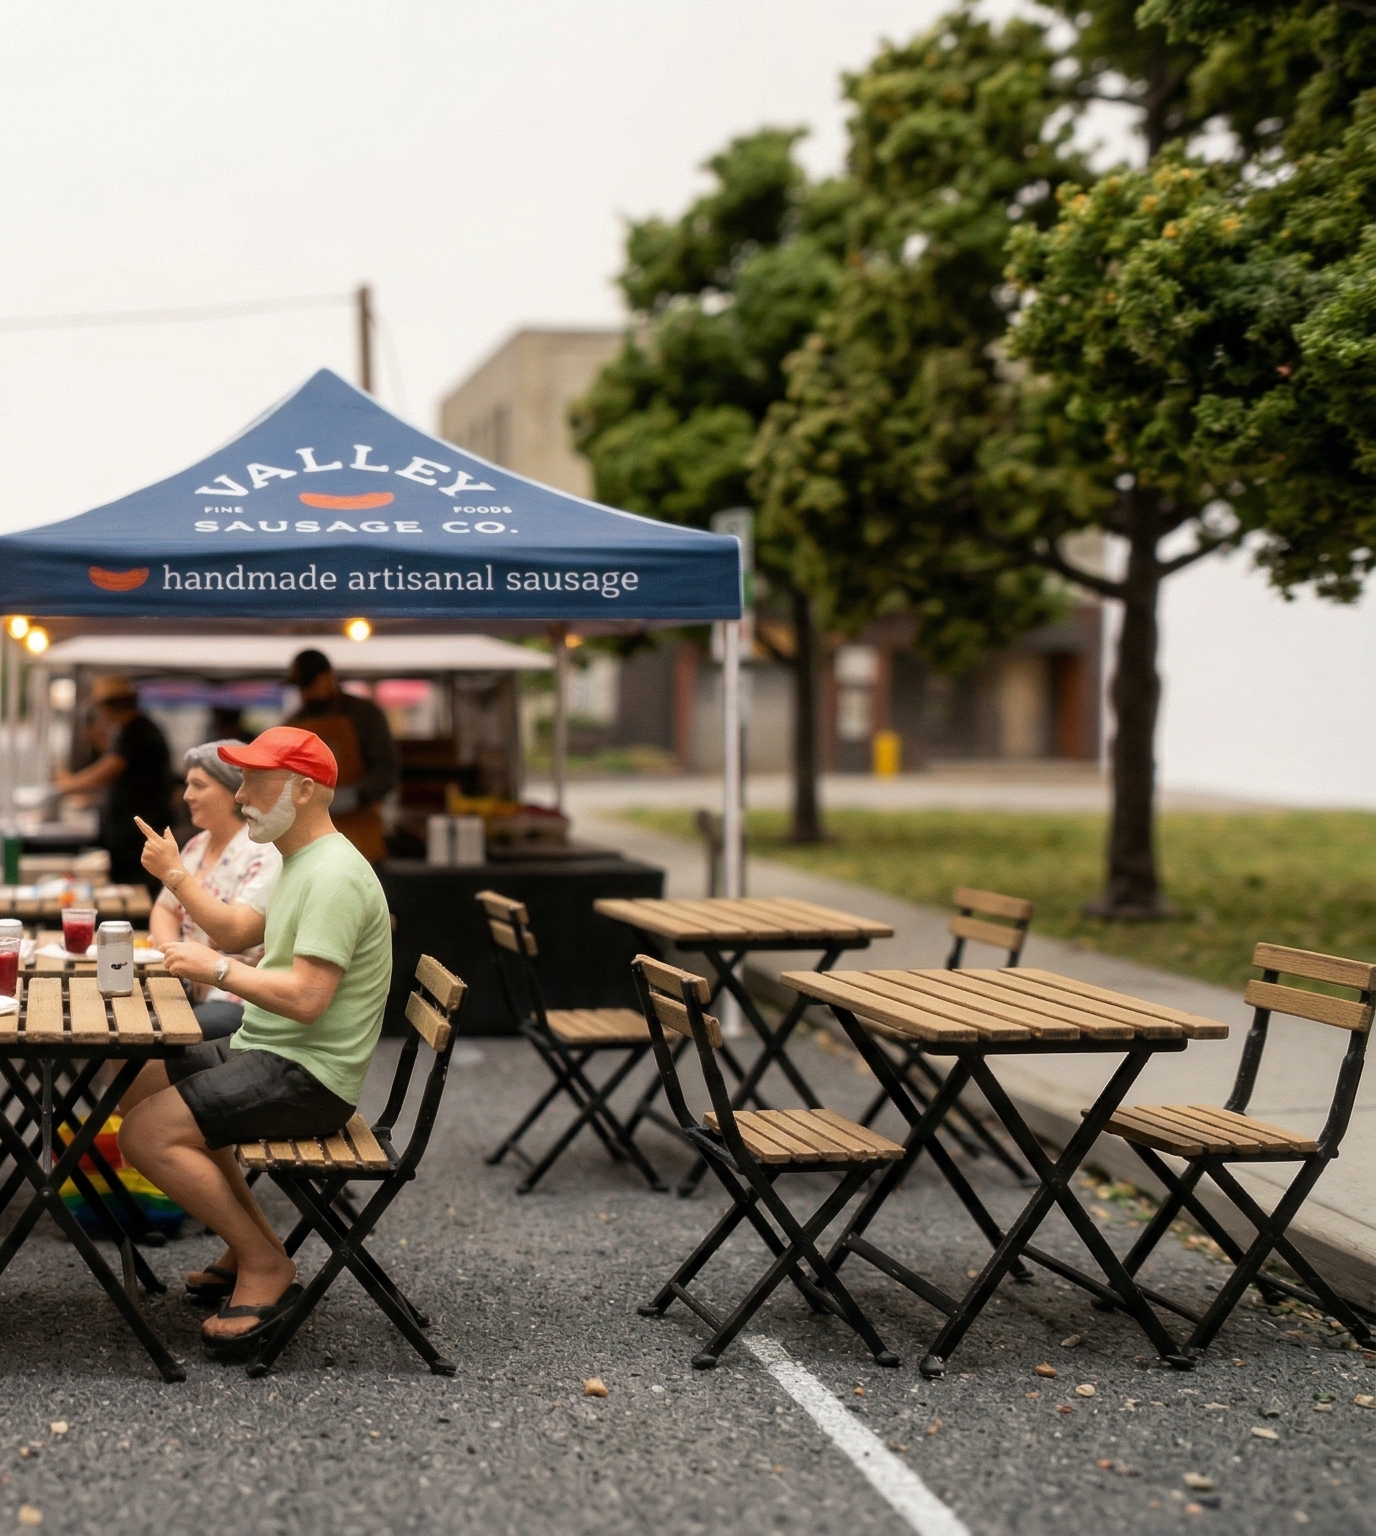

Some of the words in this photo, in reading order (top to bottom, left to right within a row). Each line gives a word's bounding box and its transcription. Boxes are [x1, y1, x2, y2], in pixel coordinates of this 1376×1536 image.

[193, 443, 497, 499] VALLEY
[204, 506, 244, 514] FINE
[453, 506, 513, 514] FOODS
[194, 520, 423, 534] SAUSAGE
[441, 520, 519, 534] CO.
[162, 564, 337, 591] handmade
[348, 564, 494, 591] artisanal
[506, 572, 639, 599] sausage
